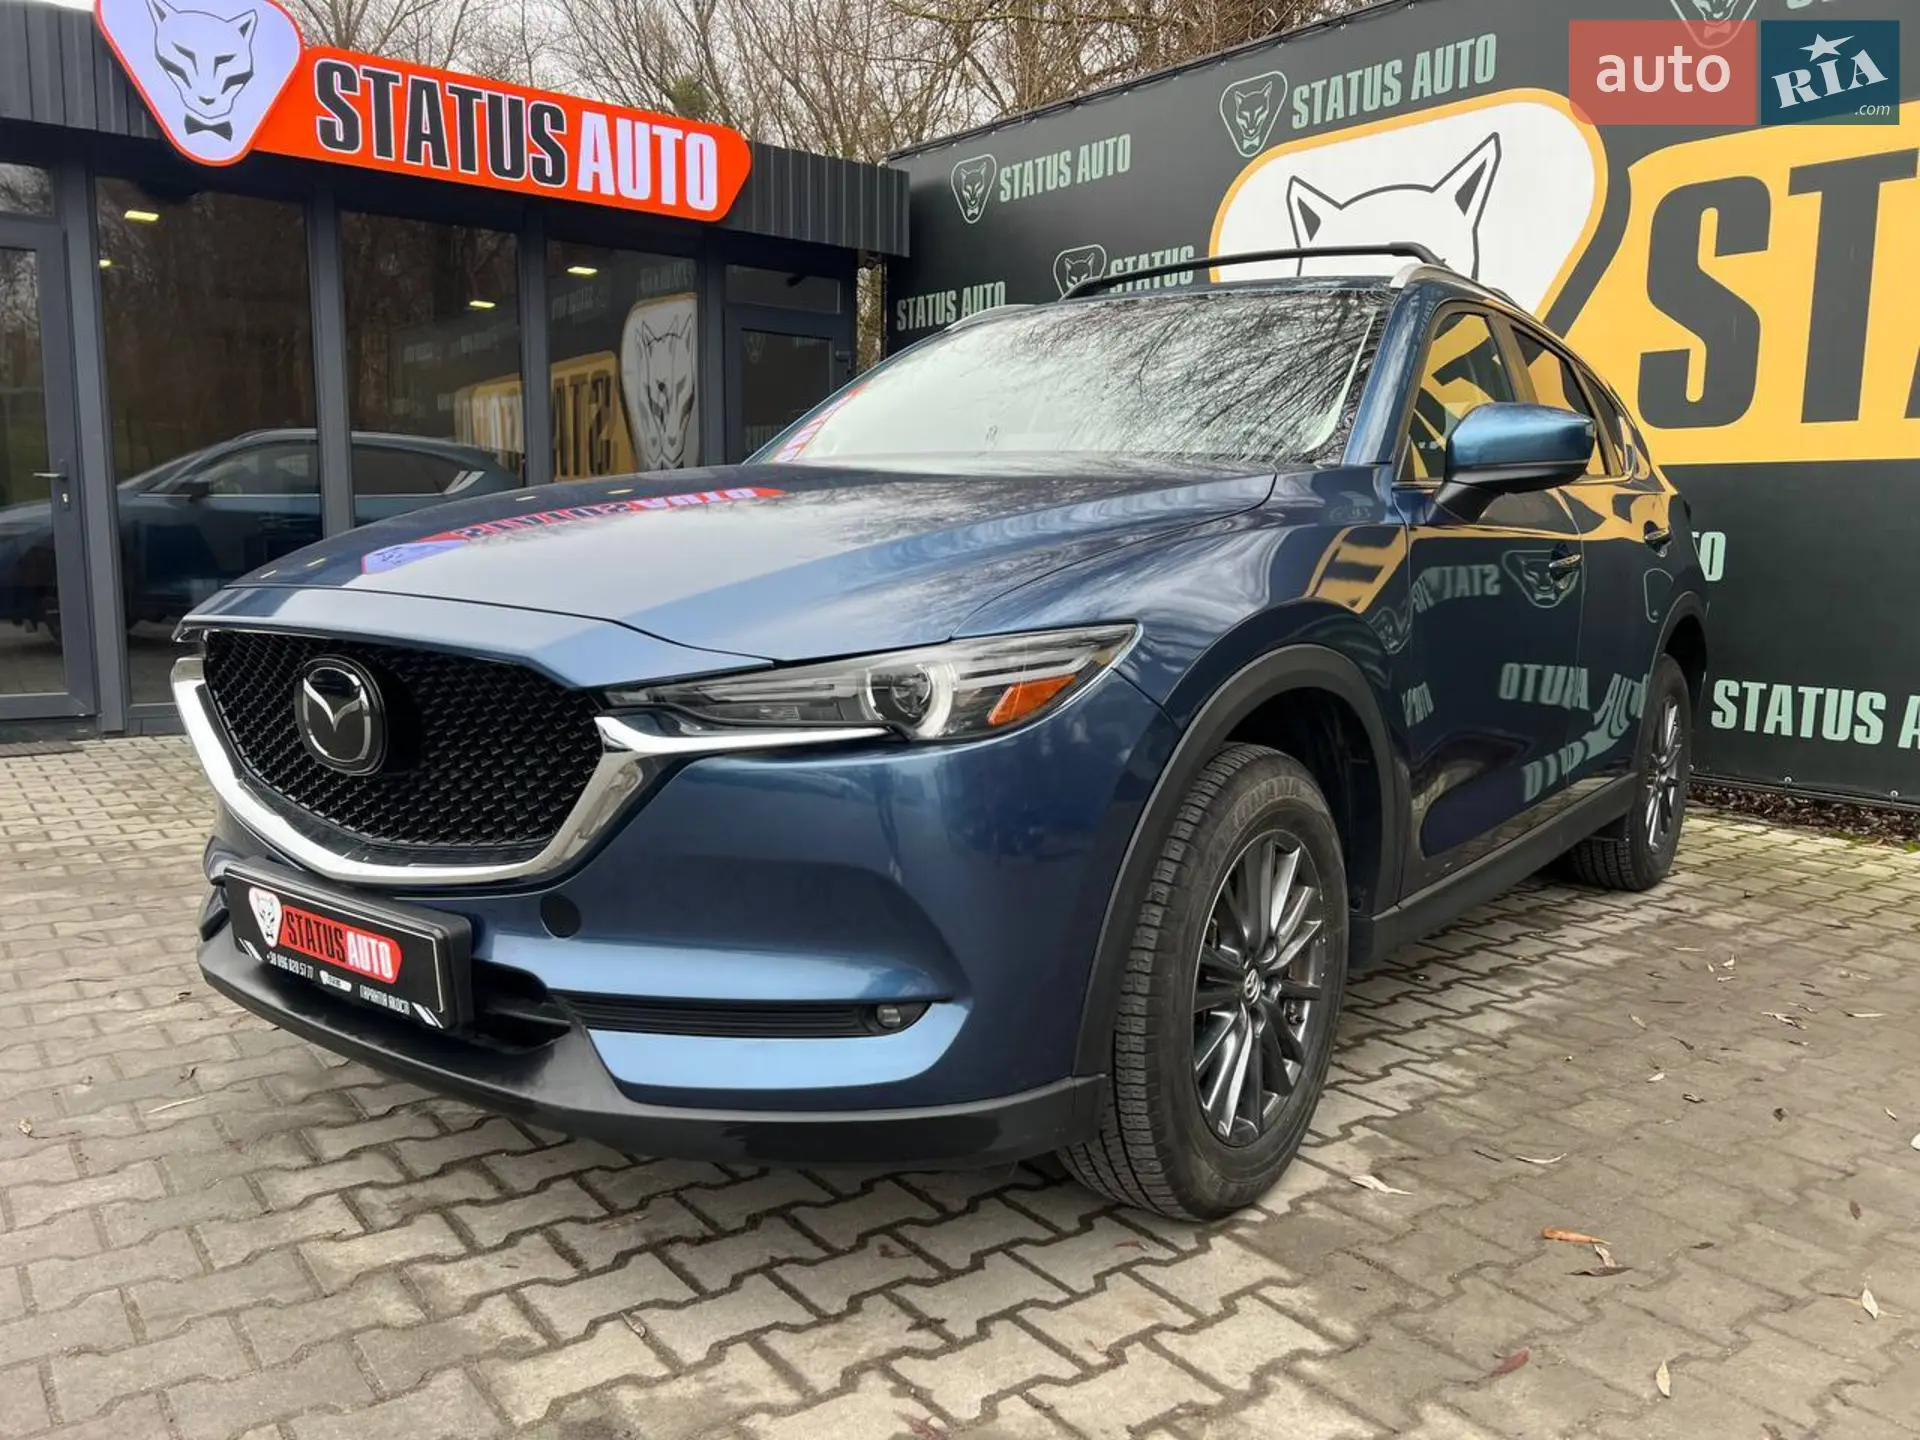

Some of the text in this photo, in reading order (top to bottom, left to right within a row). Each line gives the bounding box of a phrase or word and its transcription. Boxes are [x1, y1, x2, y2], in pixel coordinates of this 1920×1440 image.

[1292, 33, 1497, 129] STATUS AUTO
[314, 59, 718, 212] STATUS AUTO
[1000, 134, 1131, 202] STATUS AUTO
[897, 290, 957, 331] STATUS
[1637, 147, 1920, 430] ST
[1711, 679, 1887, 745] STATUS
[286, 911, 394, 979] STATUS AUTO
